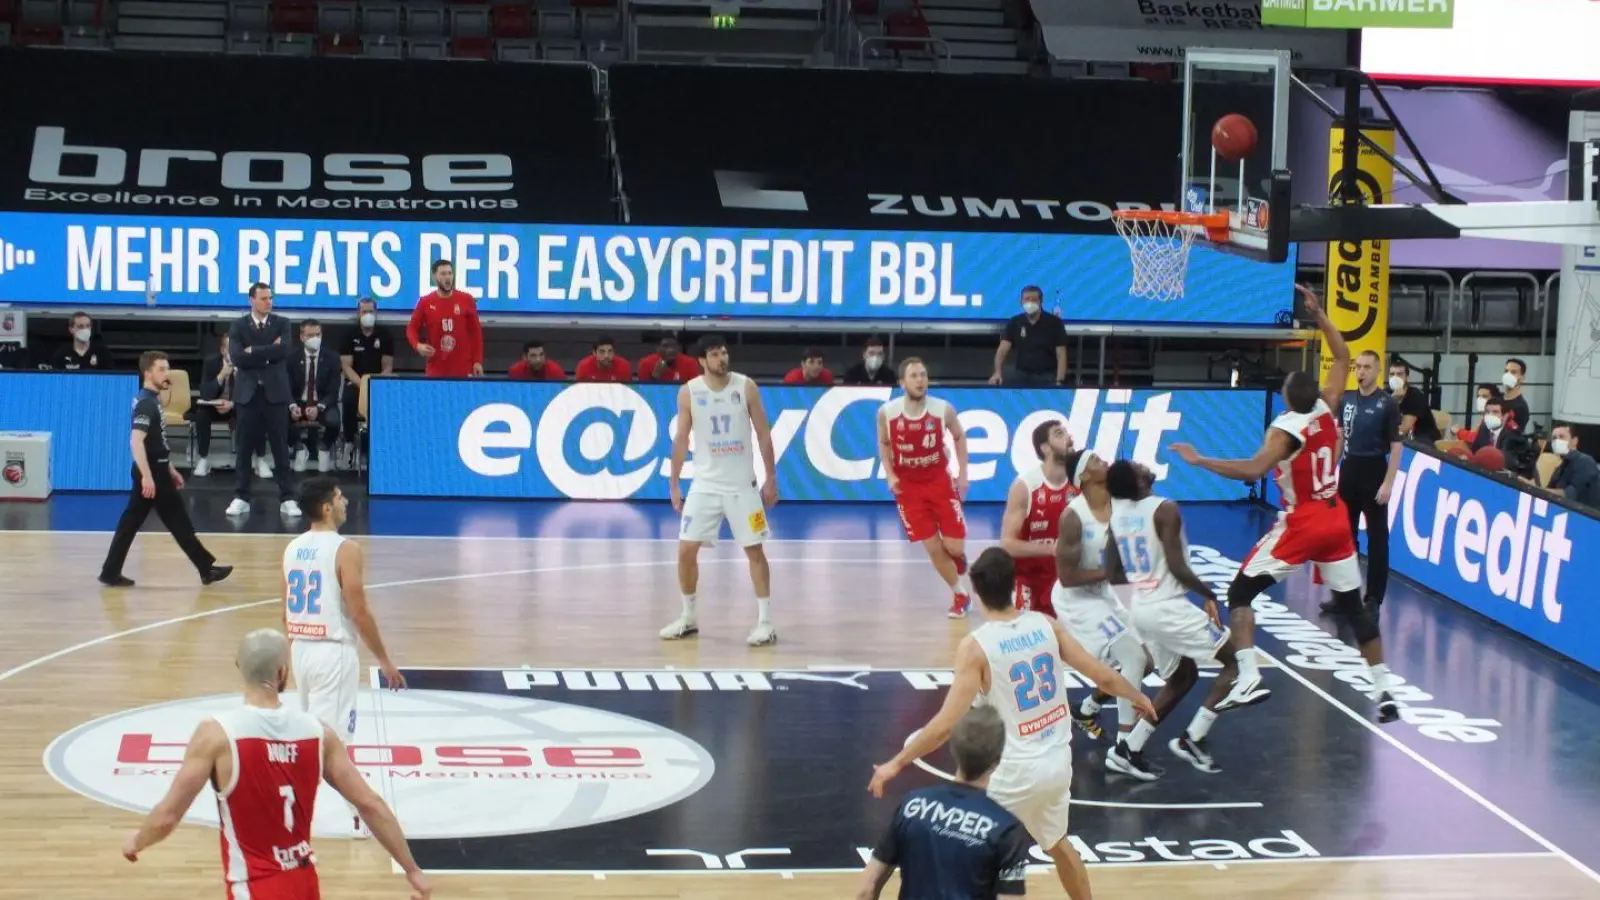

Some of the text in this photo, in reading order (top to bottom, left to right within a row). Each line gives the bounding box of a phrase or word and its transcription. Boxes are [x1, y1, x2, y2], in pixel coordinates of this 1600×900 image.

[29, 126, 514, 192] brose
[24, 188, 519, 211] Excellence in Mechatronics
[867, 193, 1176, 222] ZUMTO
[66, 223, 983, 308] MEHR BEATS DER EASYCREDIT BBL.
[709, 414, 732, 436] 17
[1117, 535, 1151, 573] 15
[287, 569, 322, 615] 32
[501, 670, 773, 691] PUMA
[1008, 652, 1058, 712] 23
[117, 733, 645, 768] bose
[388, 769, 653, 781] Mechatronics
[278, 785, 296, 834] 7
[903, 796, 994, 840] GYMPER
